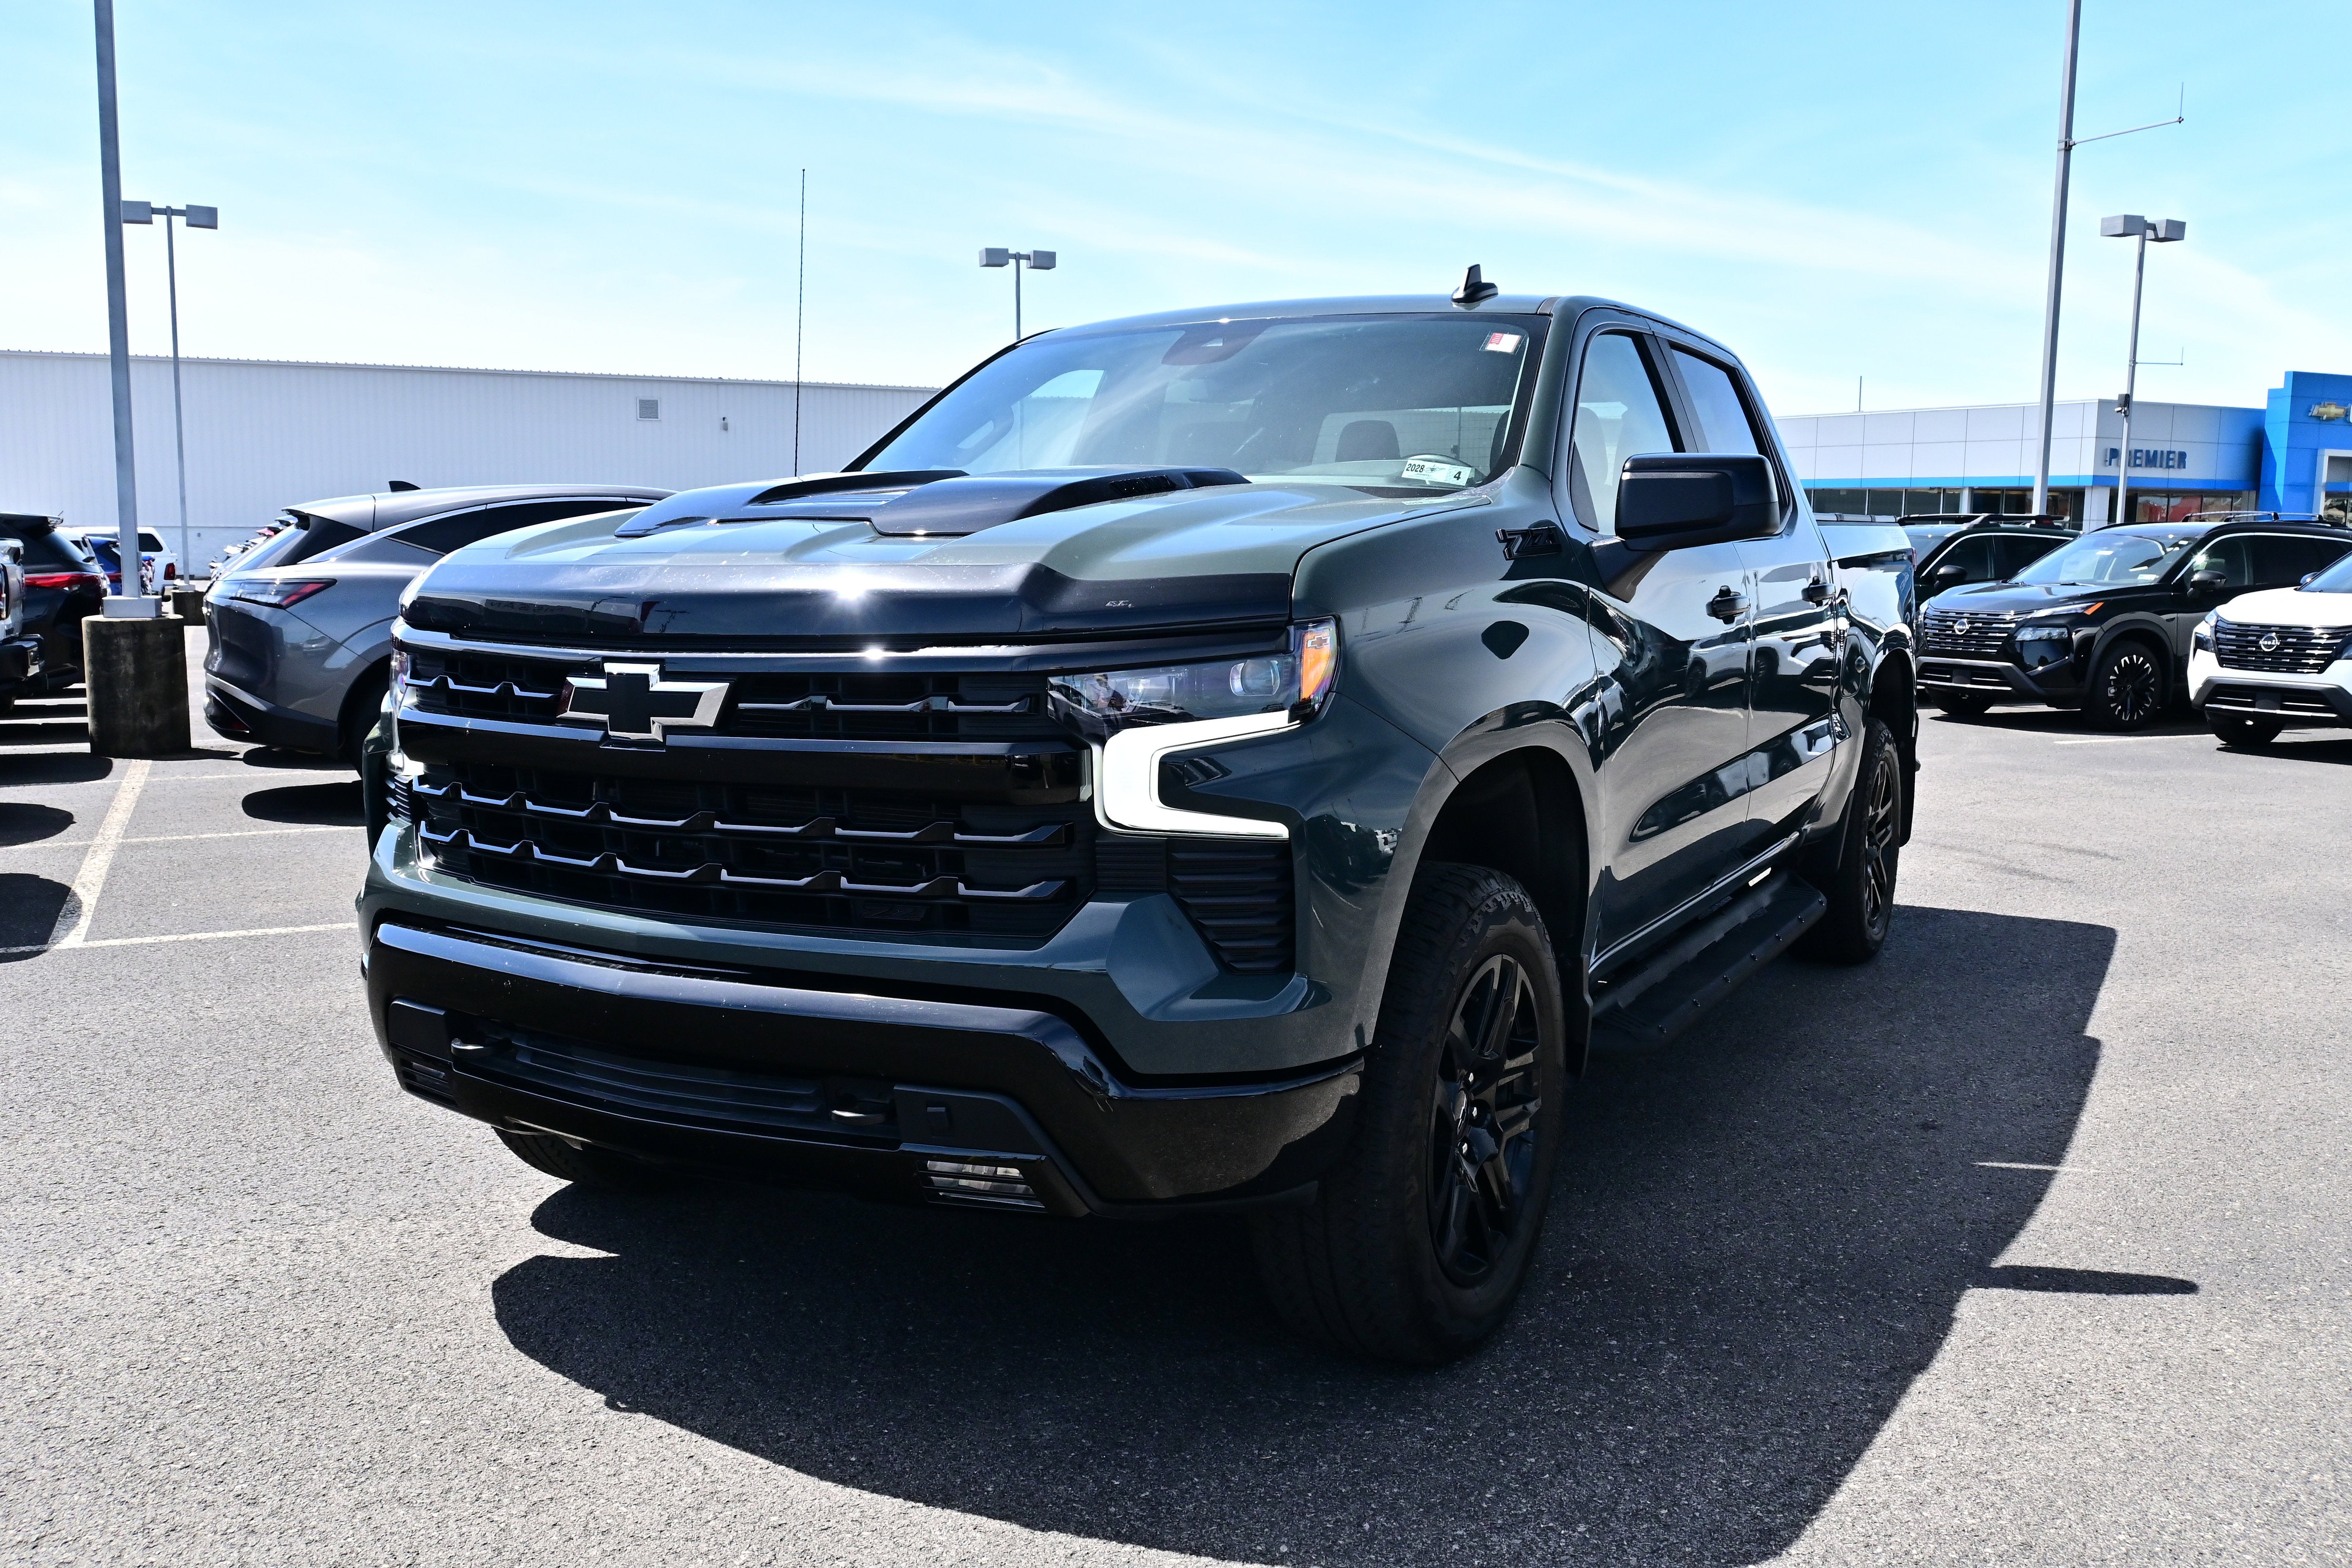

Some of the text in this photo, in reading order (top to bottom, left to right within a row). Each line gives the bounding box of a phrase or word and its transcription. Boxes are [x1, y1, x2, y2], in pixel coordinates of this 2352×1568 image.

[2106, 448, 2187, 469] PEMIER
[1406, 463, 1425, 472] 2028
[1454, 471, 1462, 480] 4
